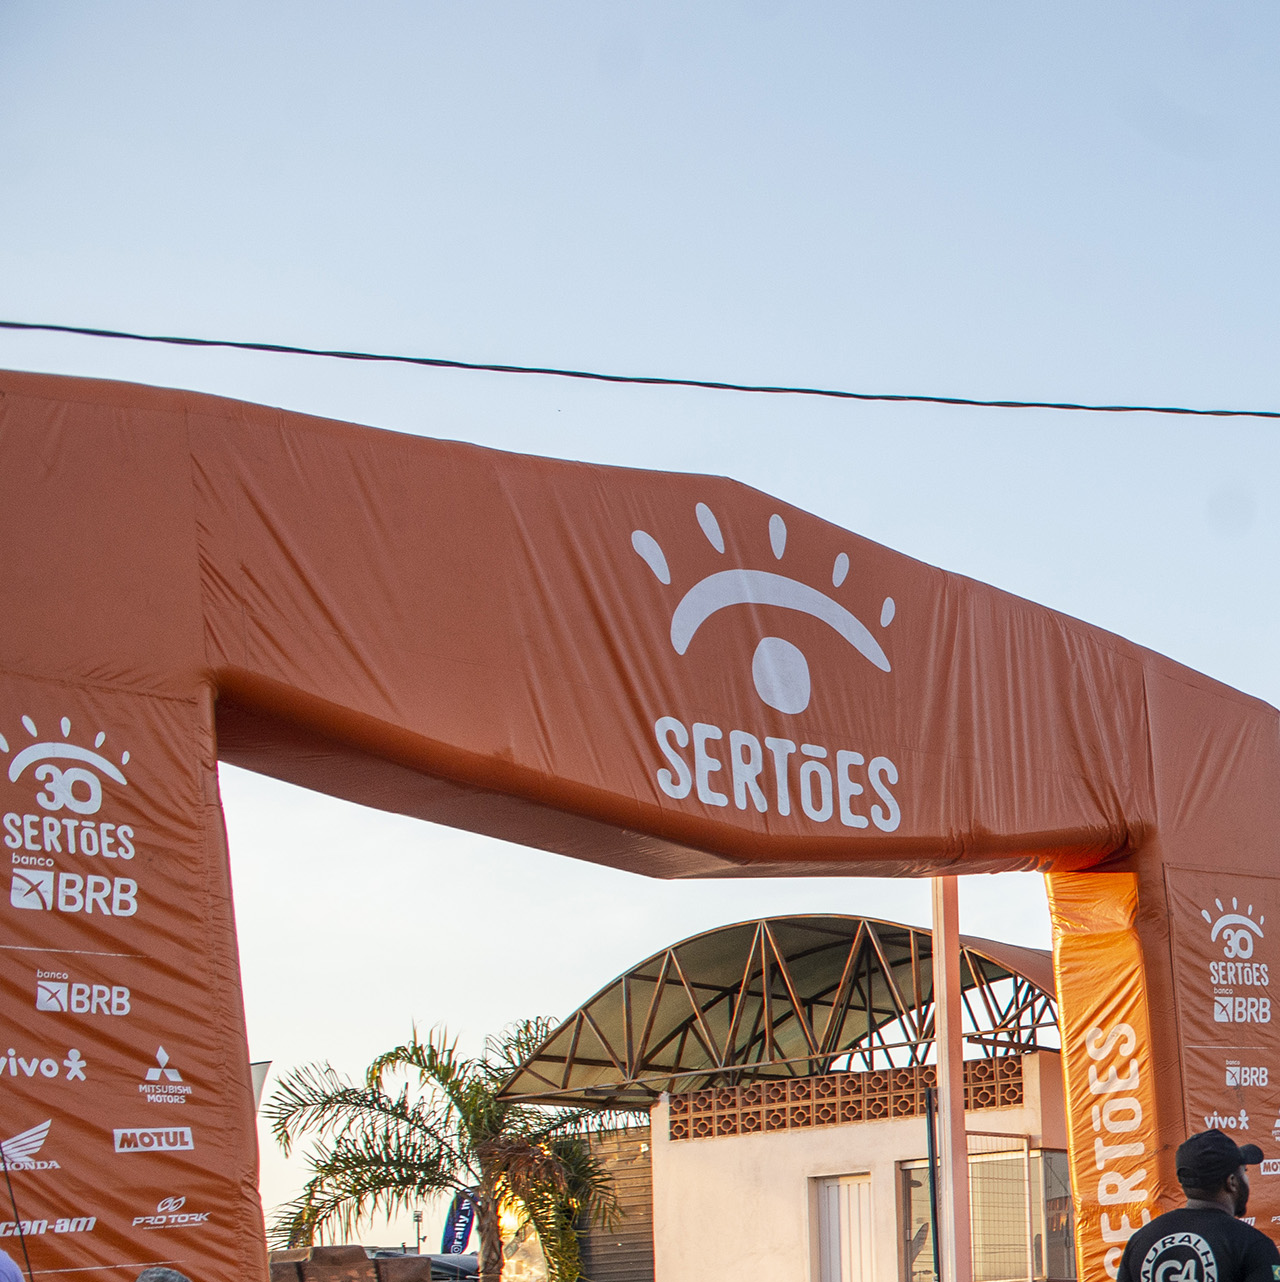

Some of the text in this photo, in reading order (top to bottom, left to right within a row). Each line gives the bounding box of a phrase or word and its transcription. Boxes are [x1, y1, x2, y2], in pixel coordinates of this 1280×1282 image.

[35, 764, 103, 815] 30
[12, 853, 54, 867] banco
[58, 872, 138, 917] BRB
[37, 968, 69, 980] banco
[71, 983, 131, 1016] BRB
[1213, 987, 1234, 995] banco
[1235, 997, 1271, 1023] BRB
[1241, 1066, 1269, 1086] BRB
[139, 1084, 192, 1095] MITSUBISHI
[146, 1094, 186, 1104] MOTORS
[1204, 1110, 1237, 1129] vivo
[119, 1131, 189, 1149] MOTUL
[0, 1217, 97, 1237] can-am
[132, 1211, 212, 1227] PRO TORK
